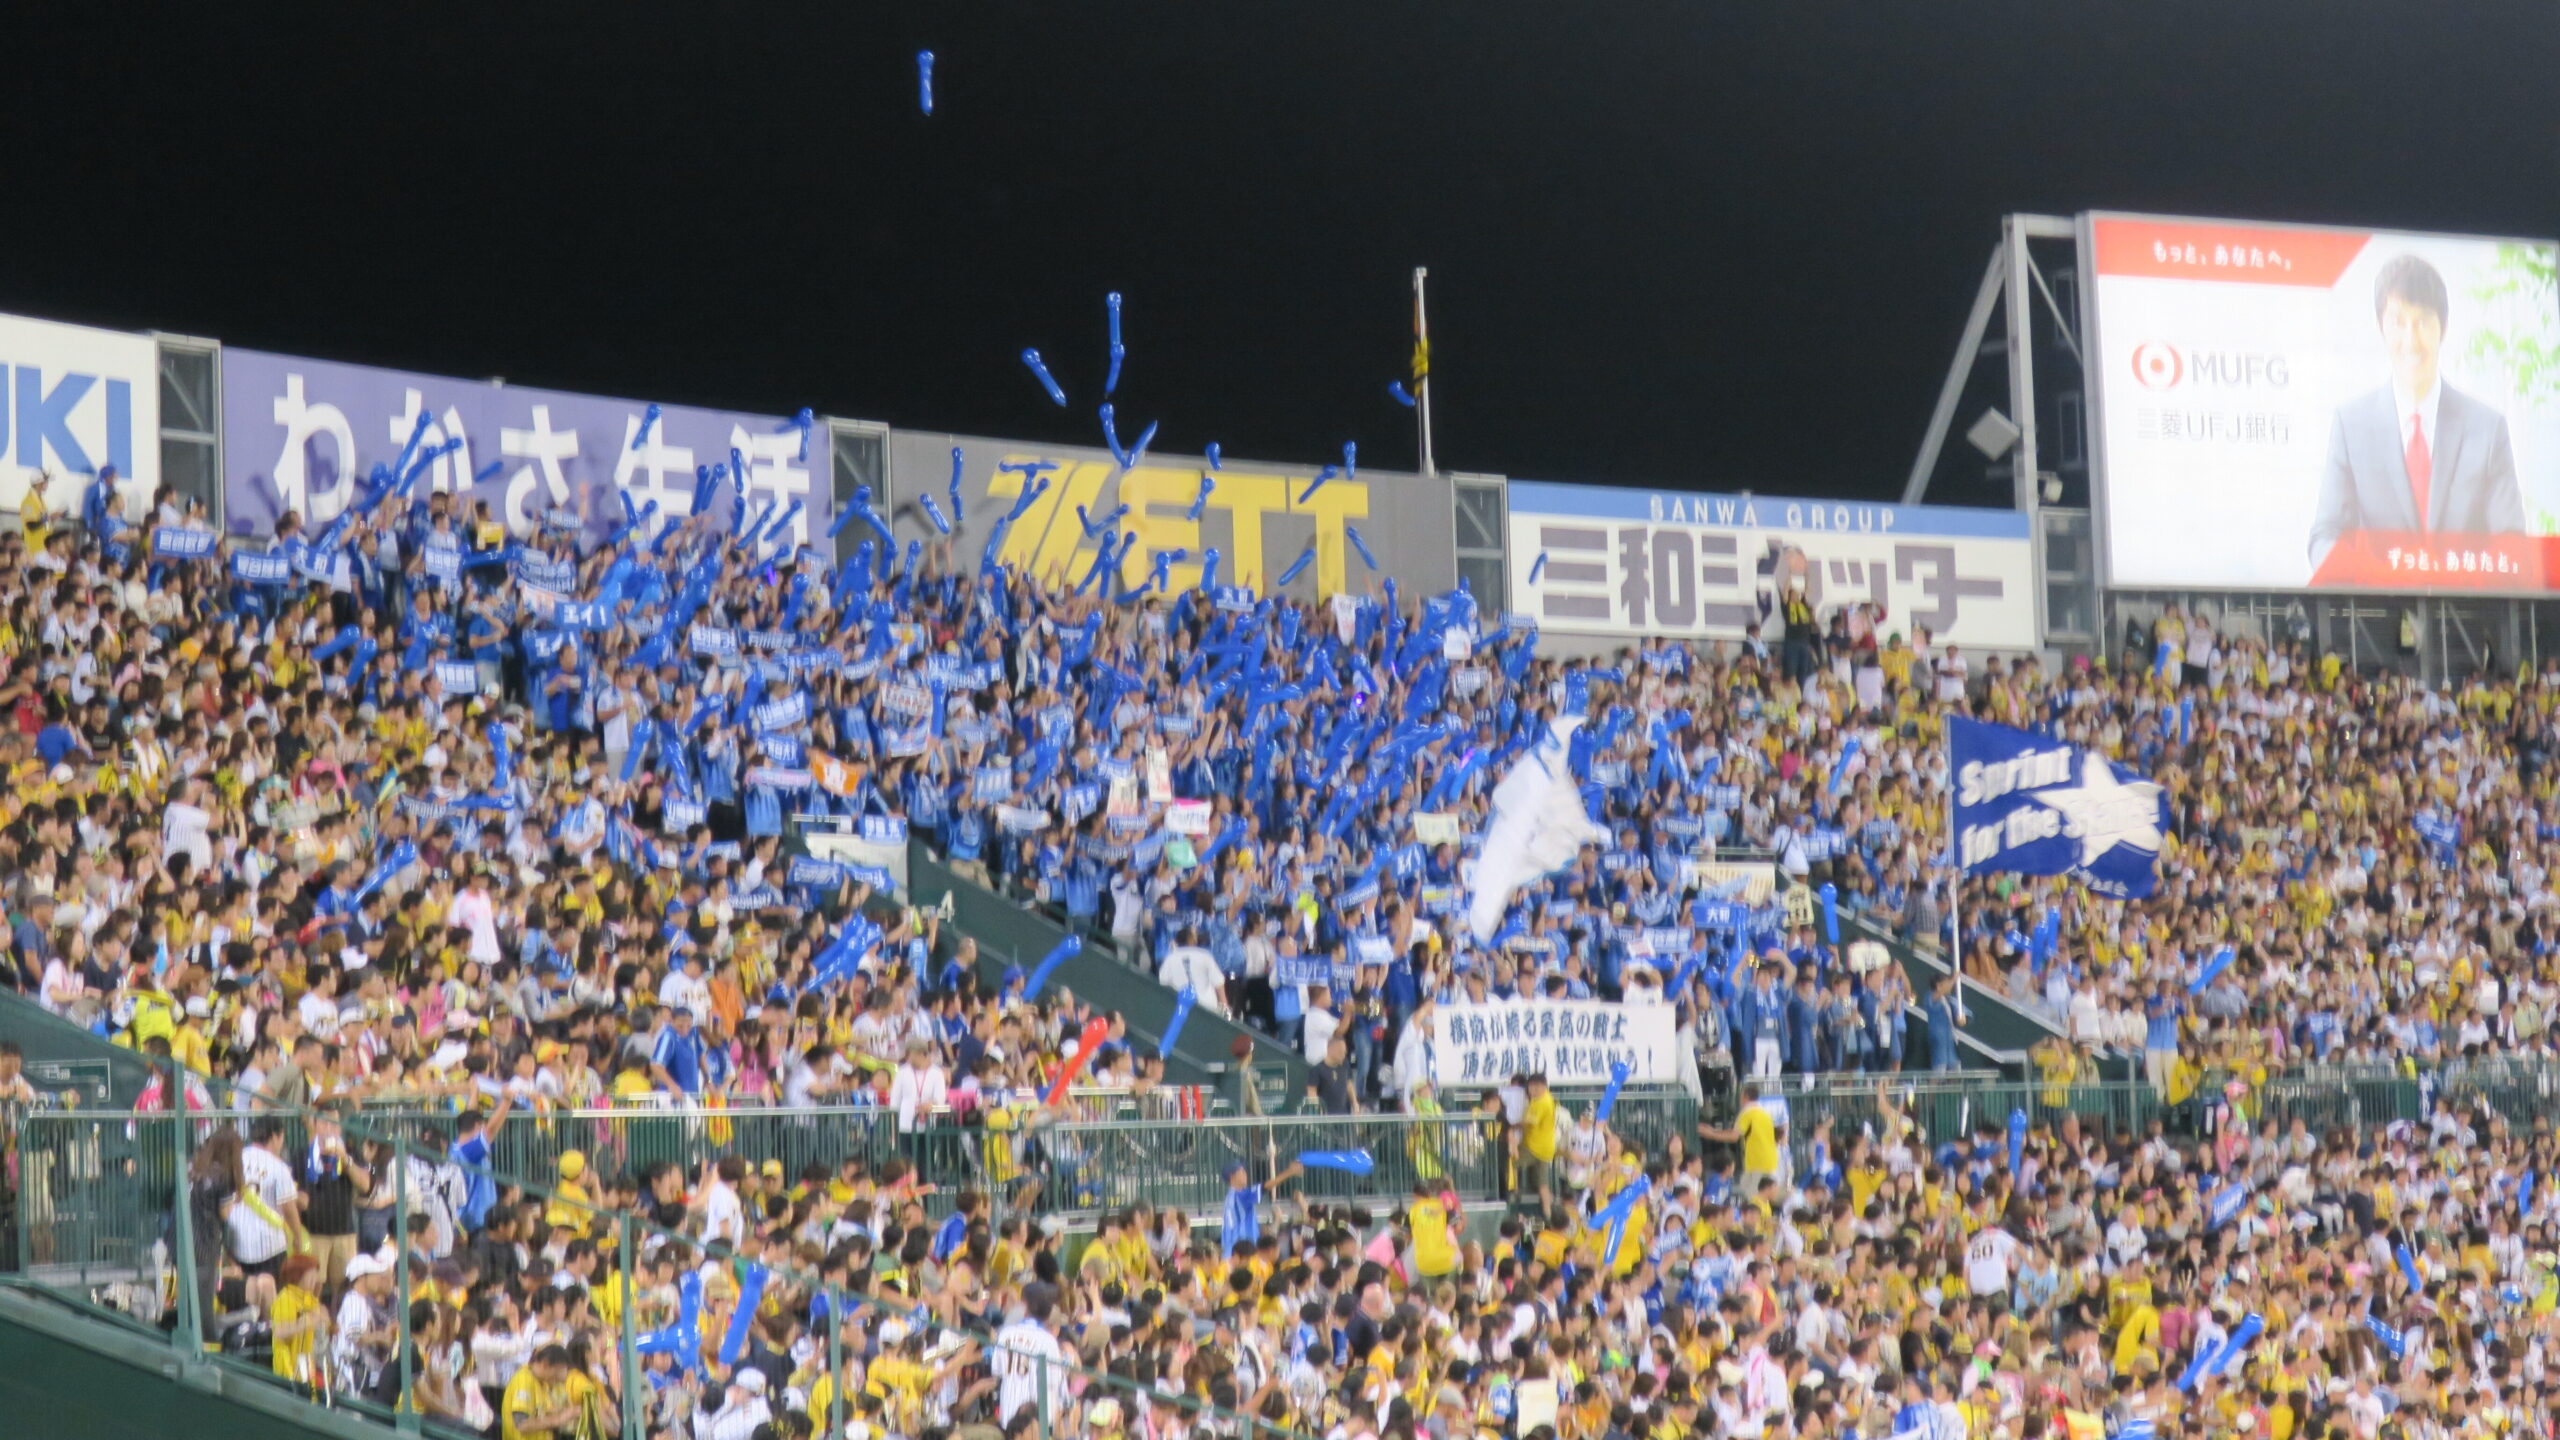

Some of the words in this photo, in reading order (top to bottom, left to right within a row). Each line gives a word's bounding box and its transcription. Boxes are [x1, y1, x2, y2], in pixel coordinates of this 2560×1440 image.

[2191, 350, 2290, 386] MUFG
[0, 362, 132, 480] KI
[2138, 408, 2290, 444] 三菱UFJ銀行
[273, 374, 811, 564] わかさ生活
[986, 454, 1370, 604] ZETT
[1651, 495, 1758, 526] SANWA
[1787, 504, 1895, 532] GROUP
[1959, 746, 2073, 808] Sprint
[1961, 820, 2005, 869] for
[2005, 805, 2061, 850] the
